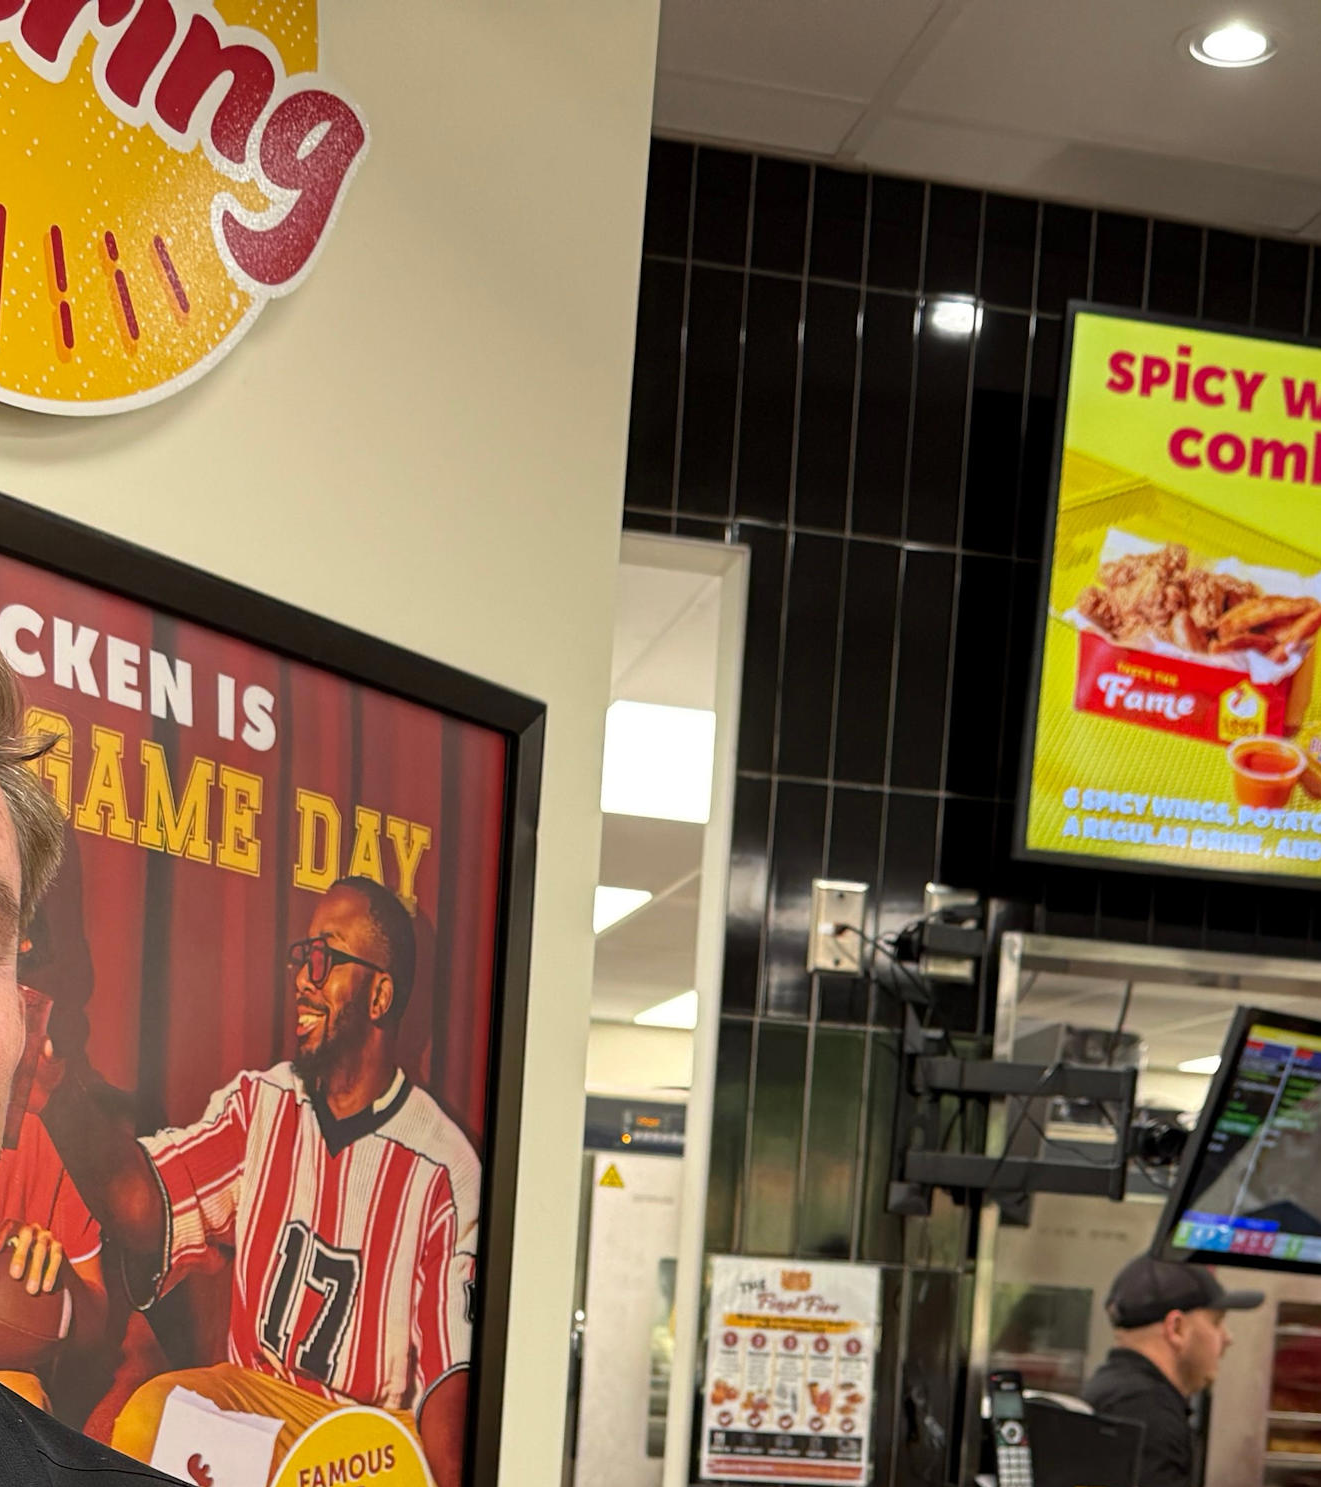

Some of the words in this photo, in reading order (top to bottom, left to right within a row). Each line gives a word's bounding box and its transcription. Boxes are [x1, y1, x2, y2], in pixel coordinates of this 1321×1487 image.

[218, 673, 277, 752] IS
[1097, 672, 1196, 719] Fame
[23, 706, 264, 878] GAME
[294, 787, 431, 918] DAY
[1062, 815, 1080, 838] A
[1083, 818, 1187, 849] REGULAR
[1081, 789, 1148, 815] SPICY
[1152, 796, 1234, 826] WINGS,
[261, 1220, 362, 1386] 17
